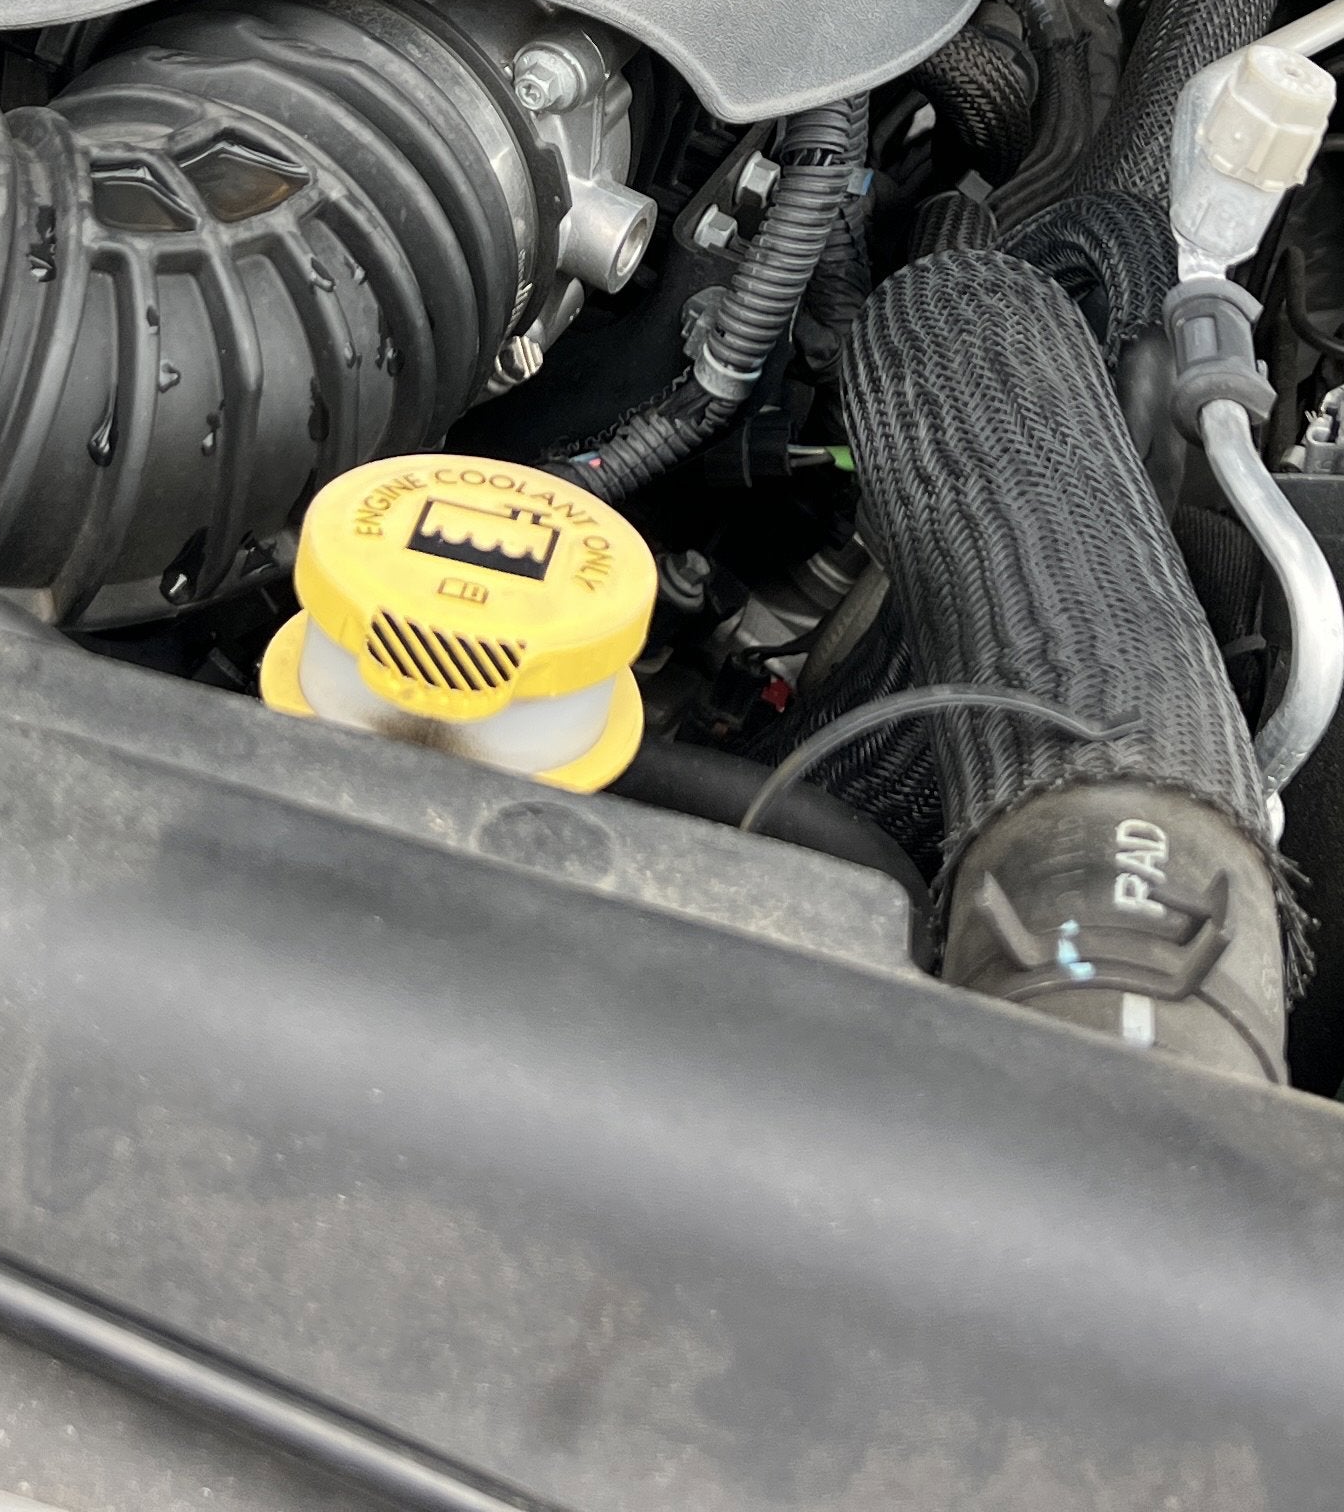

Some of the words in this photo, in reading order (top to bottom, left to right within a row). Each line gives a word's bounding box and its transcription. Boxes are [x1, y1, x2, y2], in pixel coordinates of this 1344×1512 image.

[355, 471, 430, 538] ENGINE
[433, 467, 600, 535] COOLANT
[574, 534, 615, 592] ONLY
